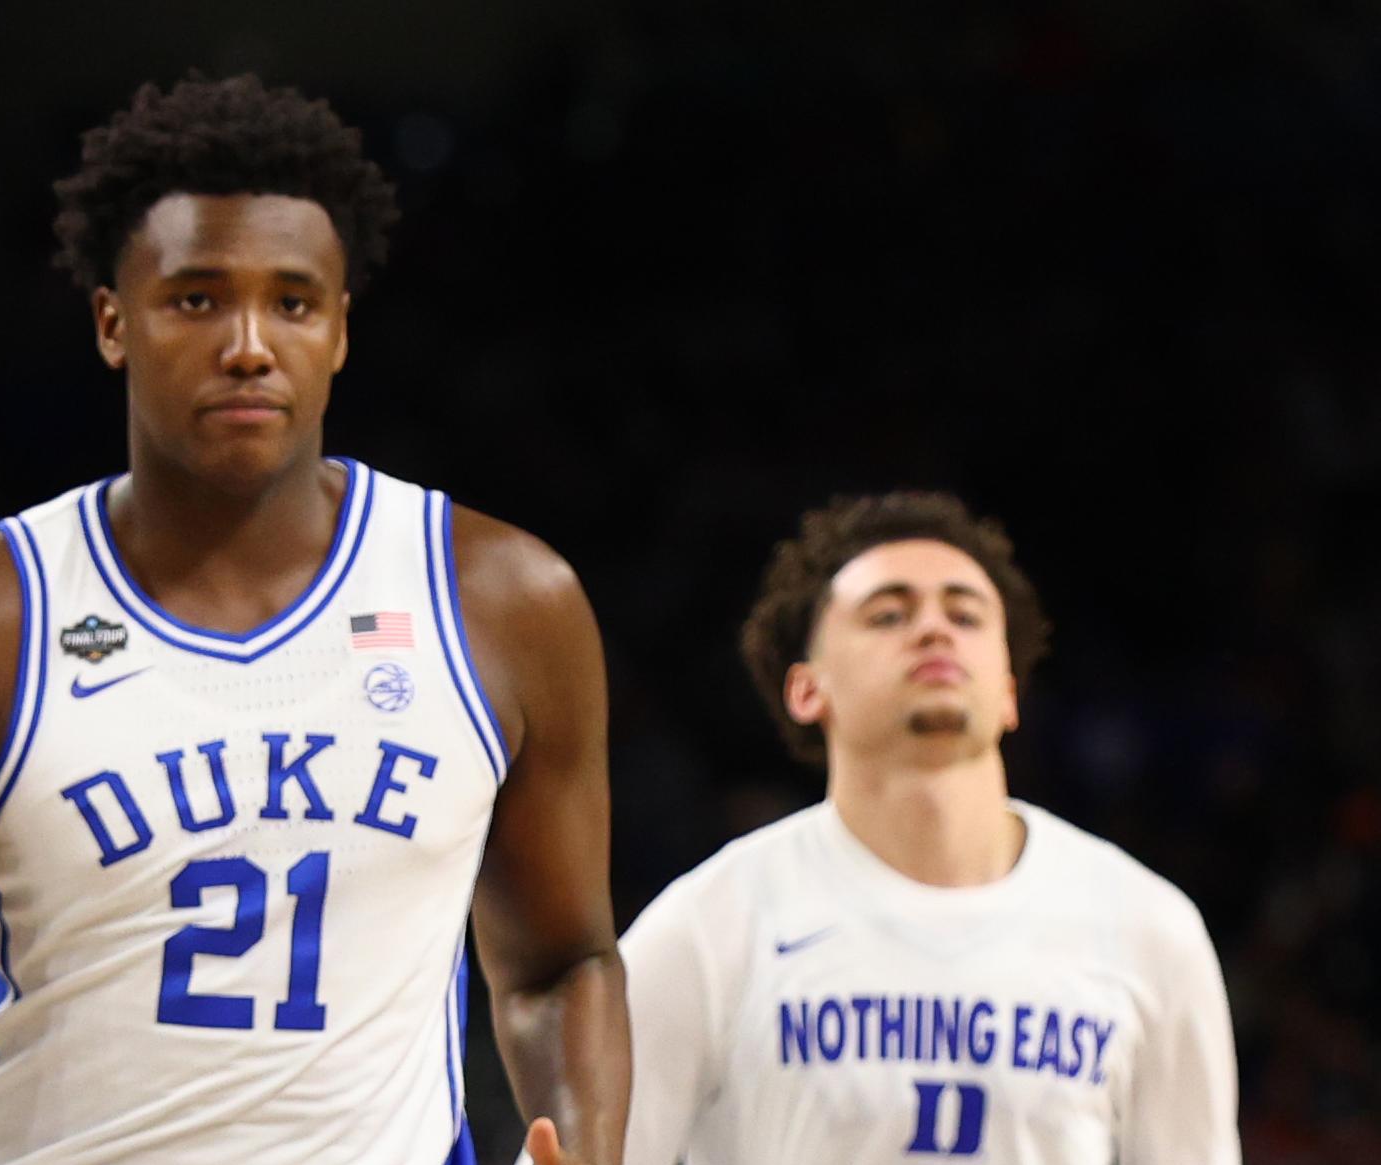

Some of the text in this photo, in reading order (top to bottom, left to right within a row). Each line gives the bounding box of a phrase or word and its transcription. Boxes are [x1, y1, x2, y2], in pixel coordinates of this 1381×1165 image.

[60, 731, 439, 868] DUKE
[156, 850, 331, 1031] 21
[777, 995, 998, 1066] NOTHING
[906, 1080, 987, 1157] D
